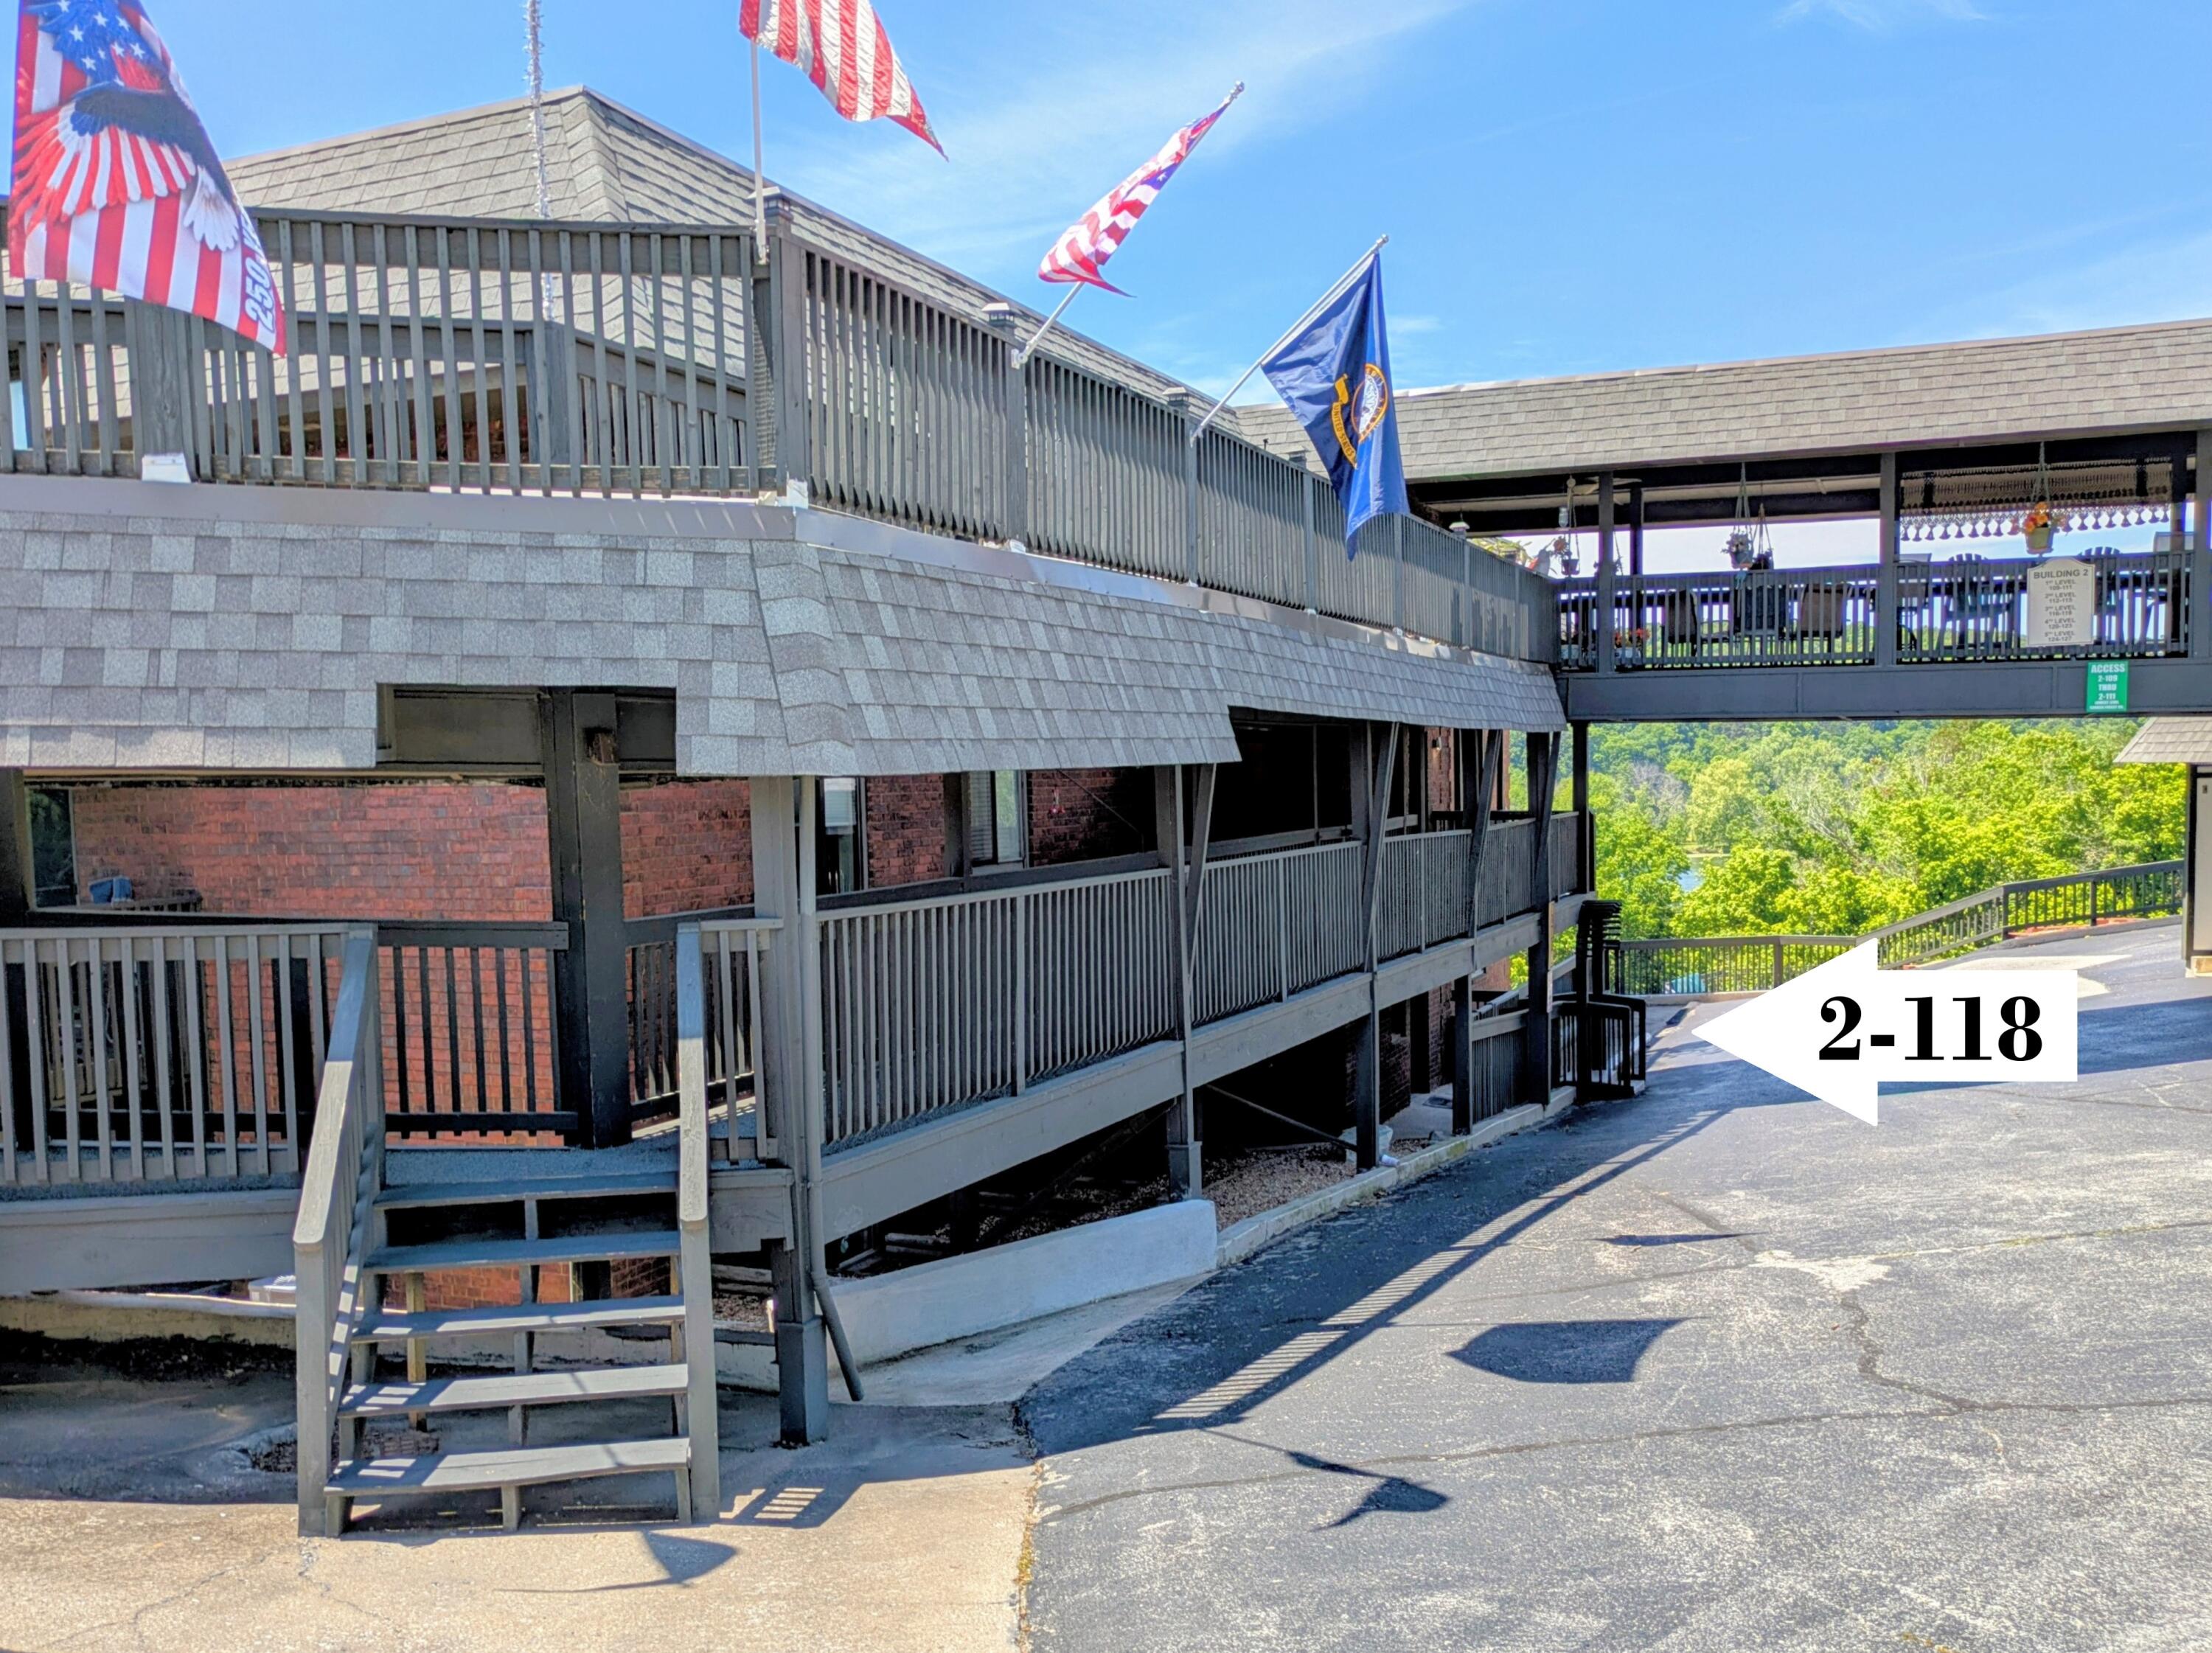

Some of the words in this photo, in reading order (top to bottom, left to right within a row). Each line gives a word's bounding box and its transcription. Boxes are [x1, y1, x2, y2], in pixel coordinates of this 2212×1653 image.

[245, 257, 274, 331] 250
[2034, 569, 2080, 579] BUILDING
[2091, 664, 2125, 673] ACCESS
